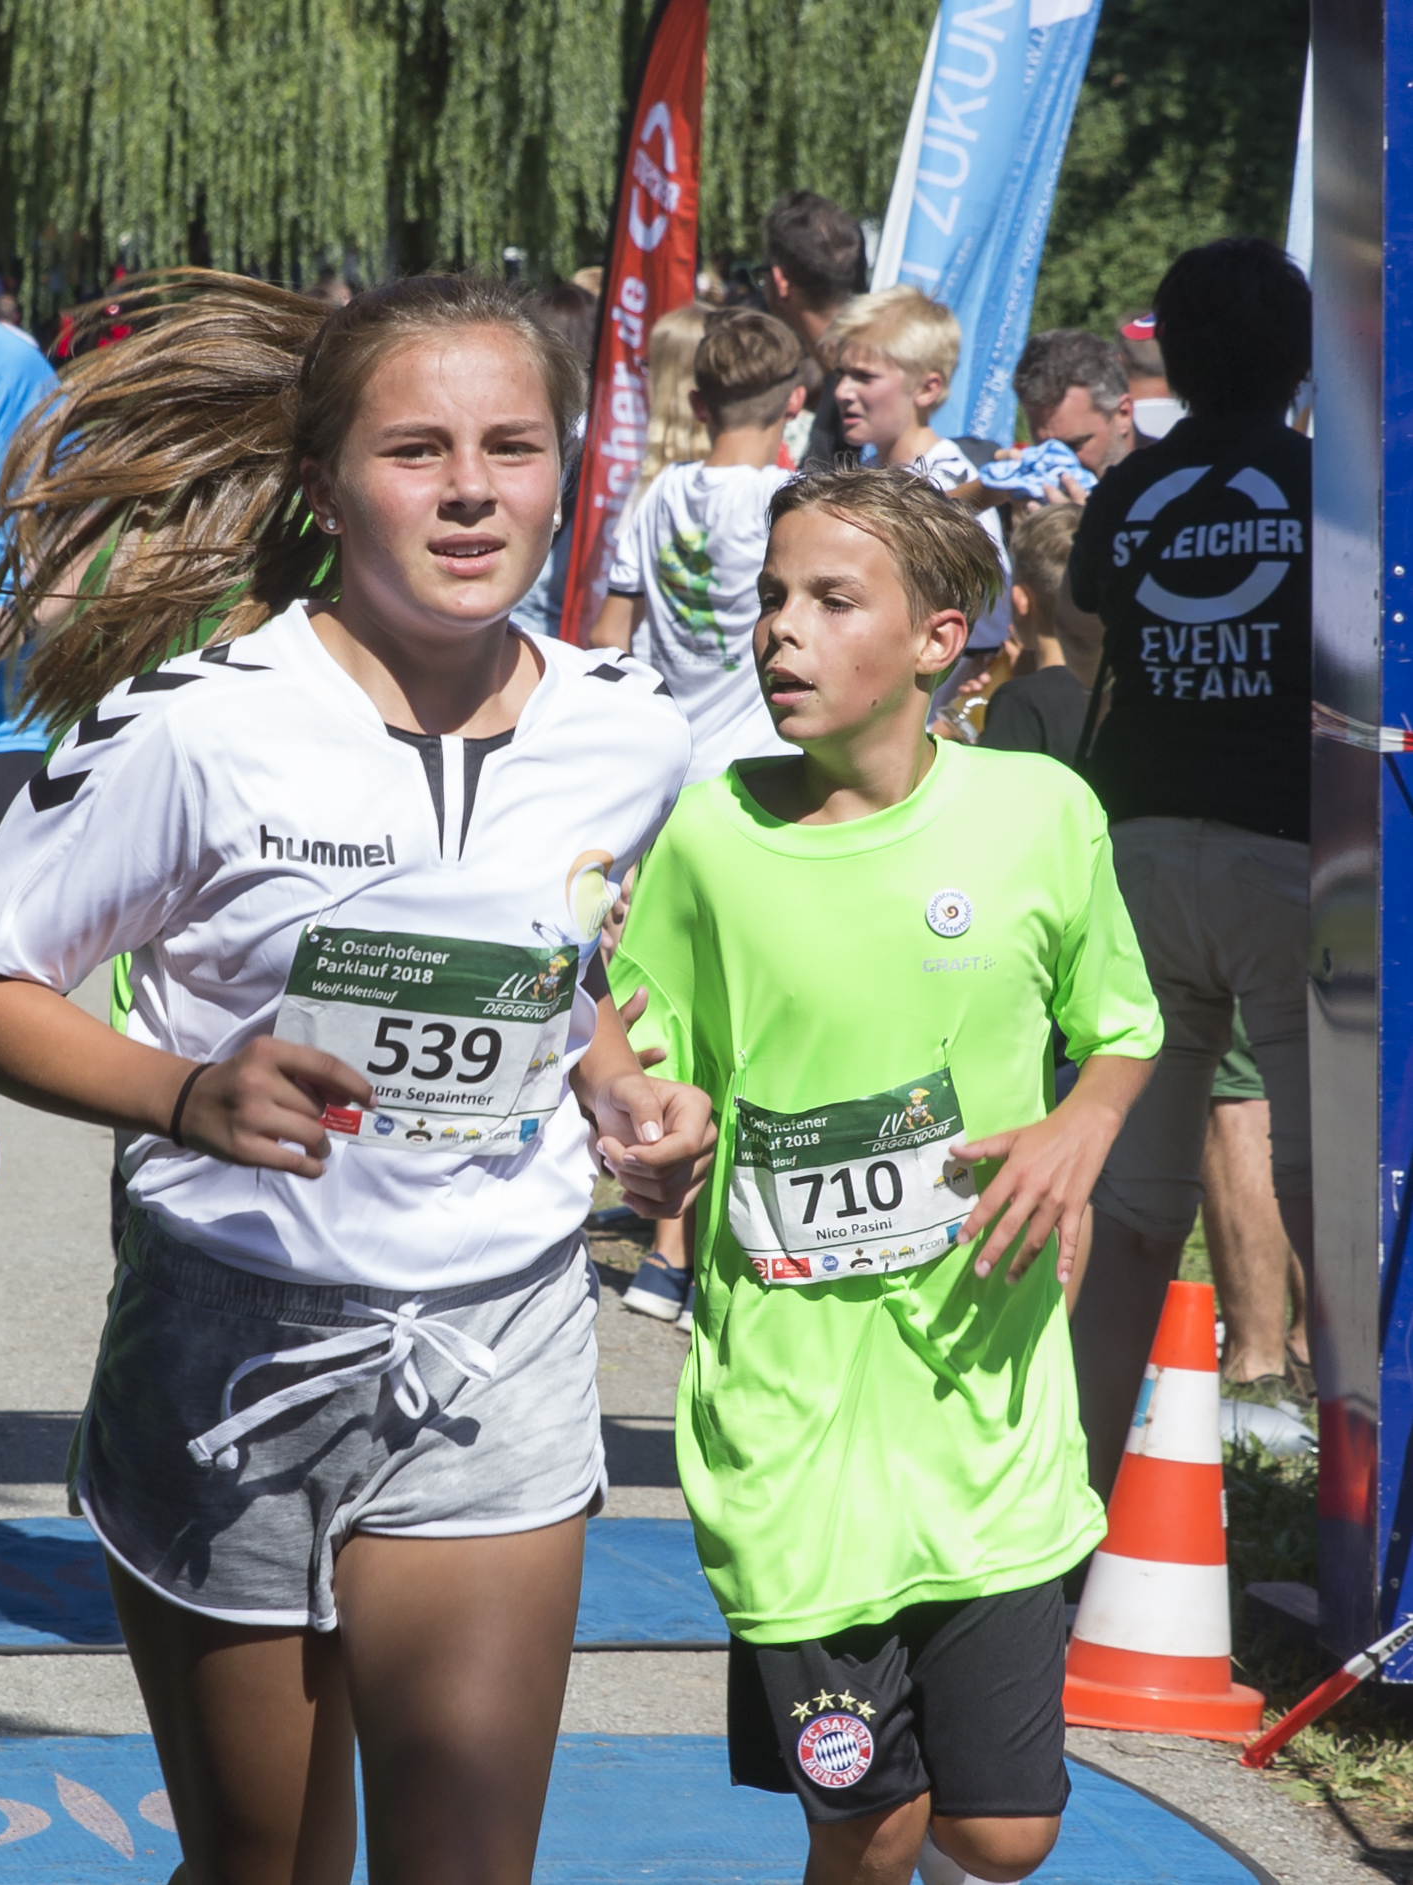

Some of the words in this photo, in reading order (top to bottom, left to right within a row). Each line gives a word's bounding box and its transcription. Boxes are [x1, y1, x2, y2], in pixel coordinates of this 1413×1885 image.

[1139, 622, 1280, 665] EVENT
[1144, 666, 1273, 701] TEAM
[260, 824, 396, 868] hummel
[321, 938, 337, 954] 2.
[340, 940, 451, 966] Osterhofener
[922, 956, 981, 973] CRAFT
[316, 957, 389, 980] Parklauf
[390, 965, 434, 985] 2018
[311, 980, 398, 1004] Wolf-Wettlauf
[496, 971, 537, 1000] LV
[366, 1016, 503, 1085] 539
[404, 1086, 495, 1107] Sepaintner
[871, 1122, 951, 1153] DEGGENDORF
[878, 1111, 906, 1139] LV
[784, 1132, 822, 1149] 2018
[789, 1160, 903, 1225] 710
[816, 1222, 848, 1241] Nico
[851, 1217, 893, 1236] Pasini
[802, 1728, 820, 1748] FC
[819, 1718, 870, 1749] BAYERN
